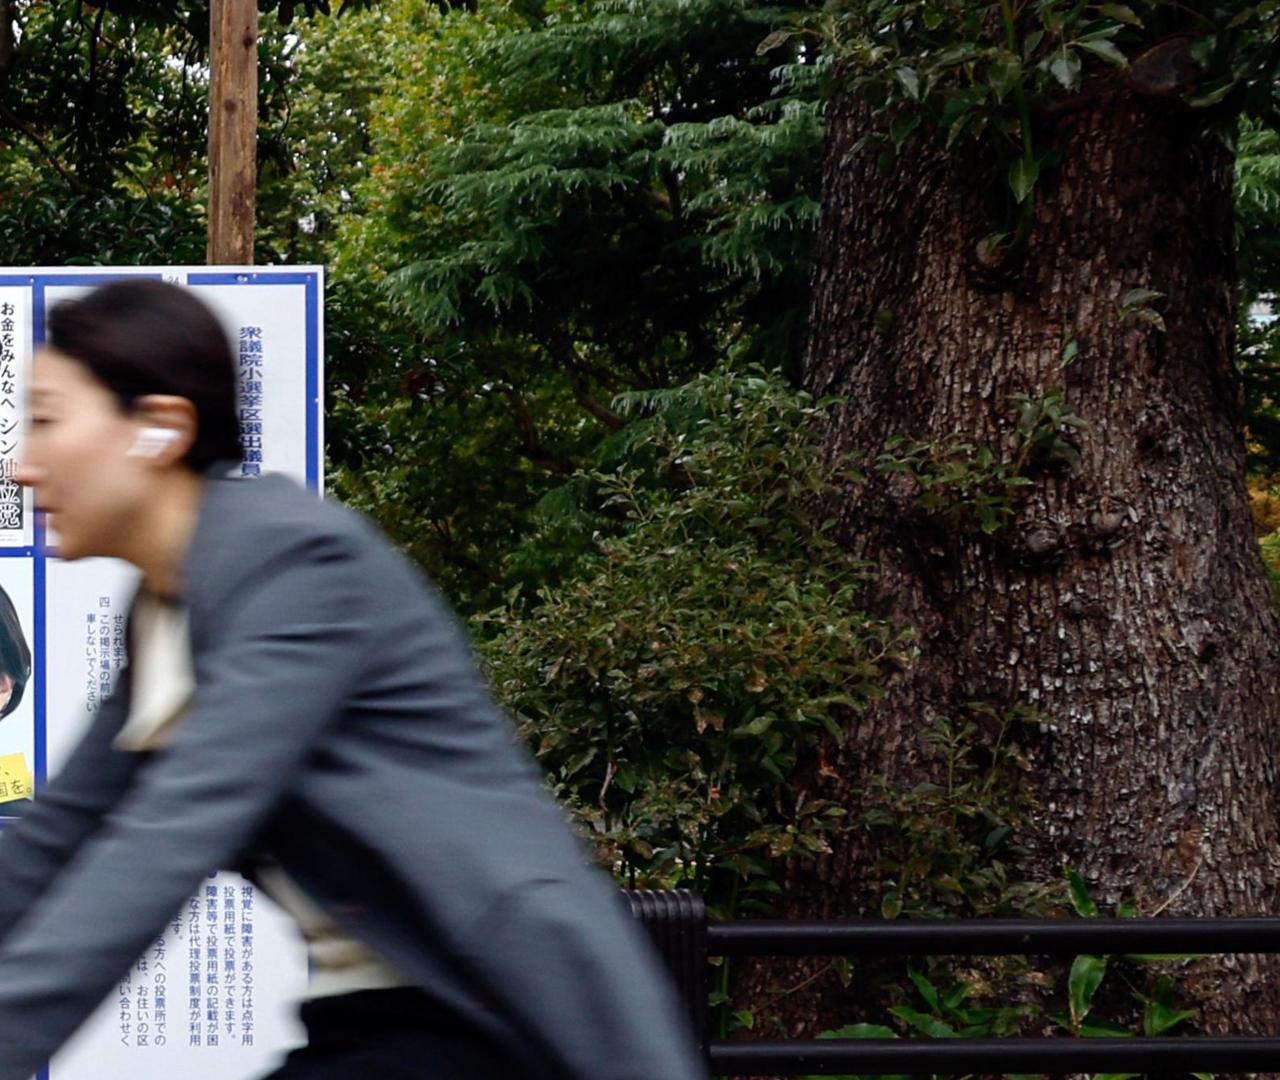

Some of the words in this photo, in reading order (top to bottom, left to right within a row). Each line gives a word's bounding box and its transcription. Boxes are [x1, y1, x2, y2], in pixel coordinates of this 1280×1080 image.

[0, 301, 16, 409] お金をみんなへ
[239, 326, 263, 477] 衆議院小選挙区選出議員
[113, 614, 124, 669] せられます
[206, 886, 219, 1047] 障害等で投票用紙の記載が困
[224, 886, 236, 1039] 投票用紙で投票ができます。
[241, 886, 254, 1047] 視覚に障害がある方は点字用
